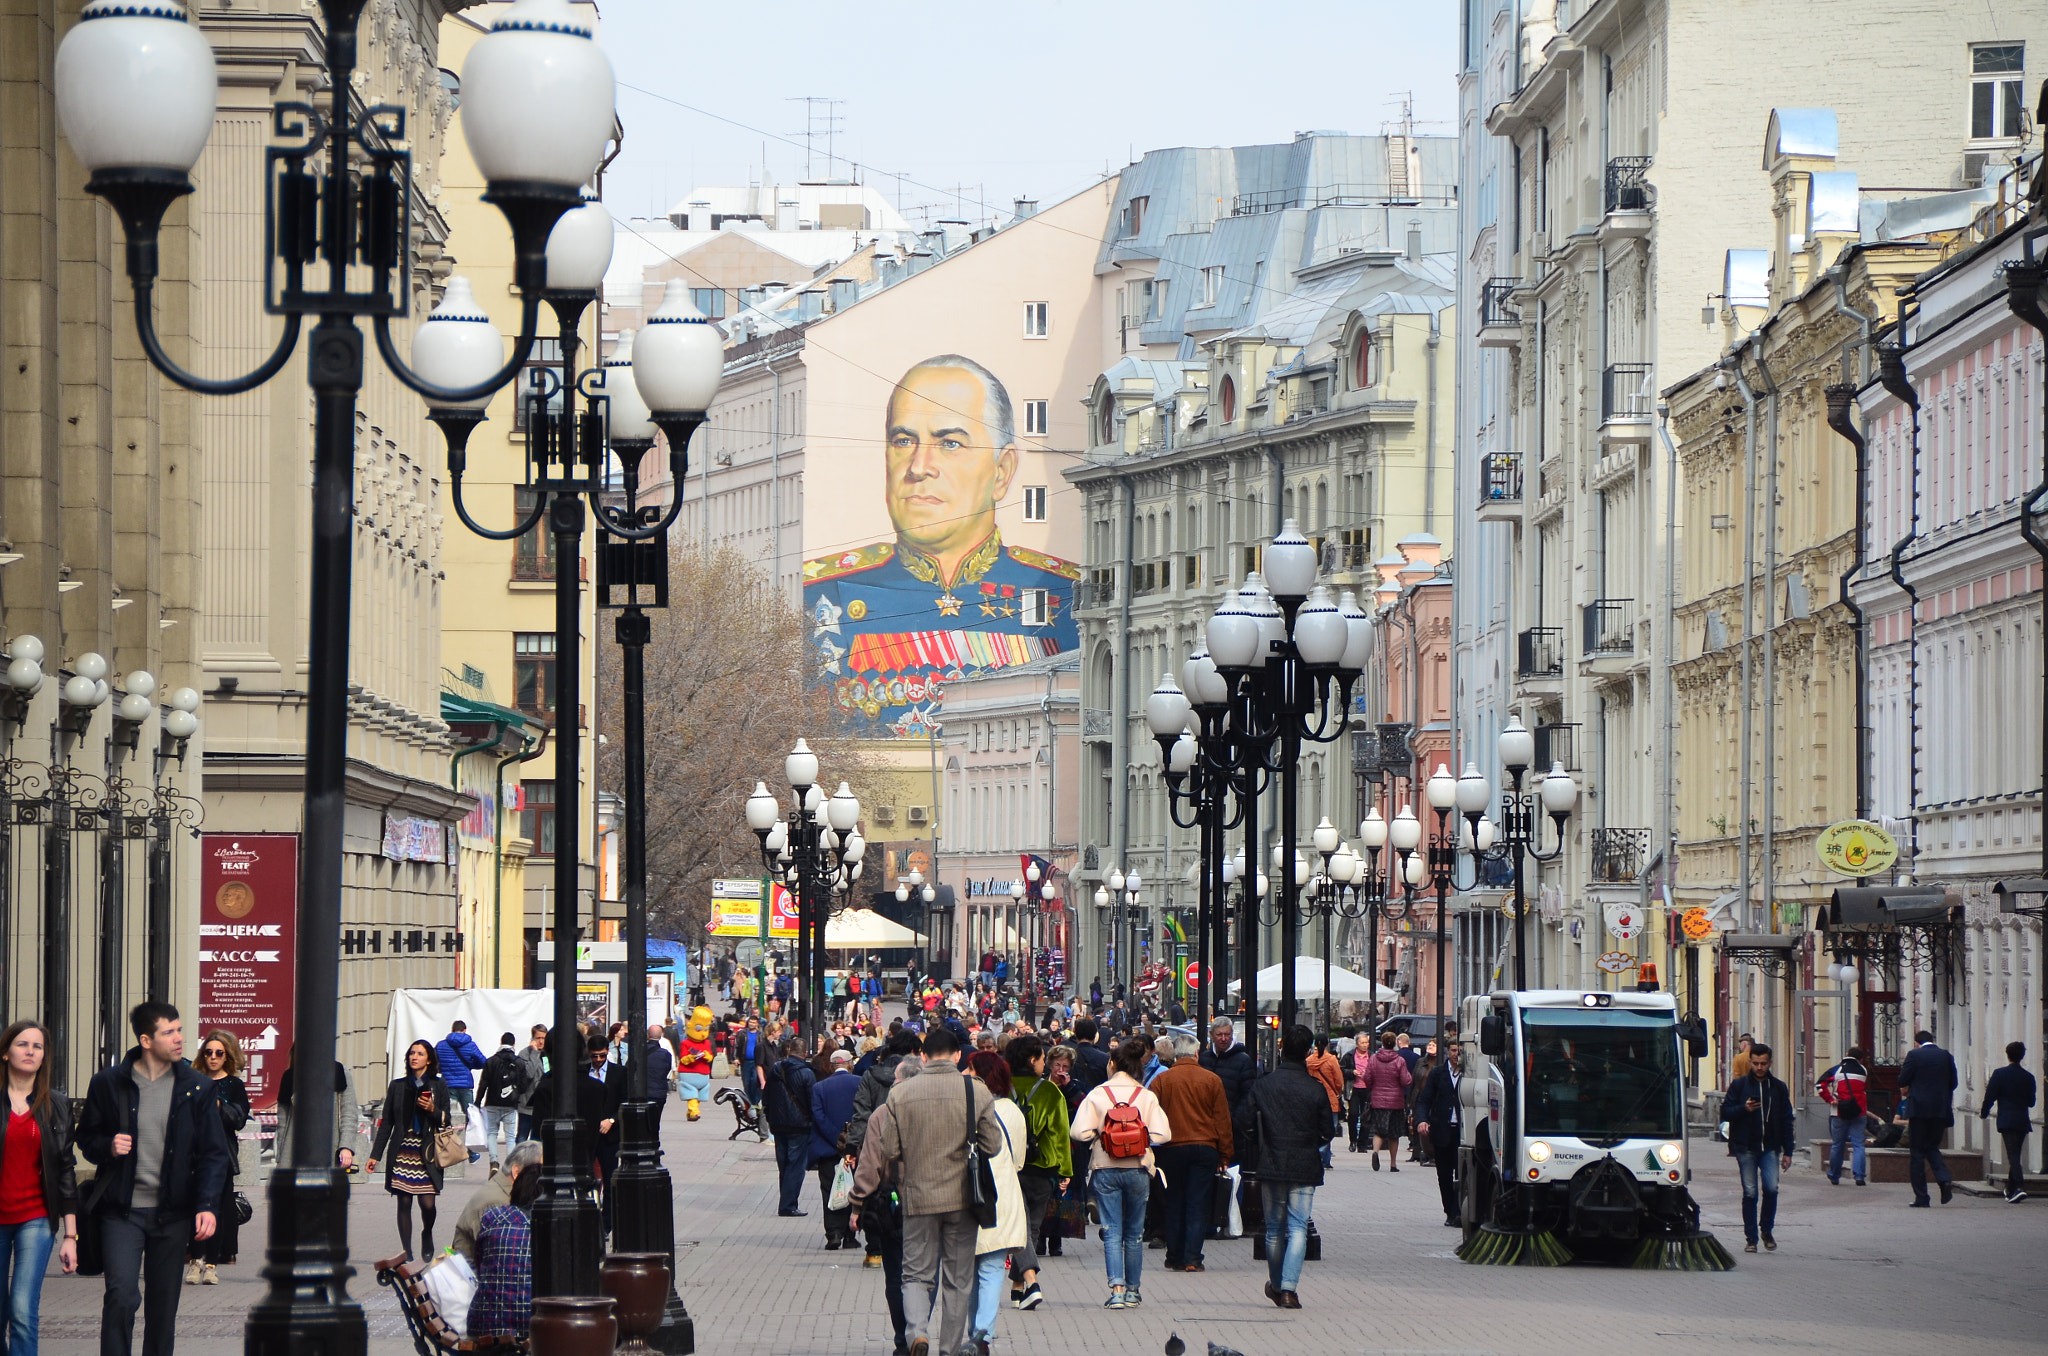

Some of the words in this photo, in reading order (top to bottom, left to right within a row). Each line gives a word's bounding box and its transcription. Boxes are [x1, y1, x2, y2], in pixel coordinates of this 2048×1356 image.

[221, 862, 251, 870] ТЕАТР
[216, 924, 268, 940] СЦЕНА
[211, 950, 260, 962] КАССА
